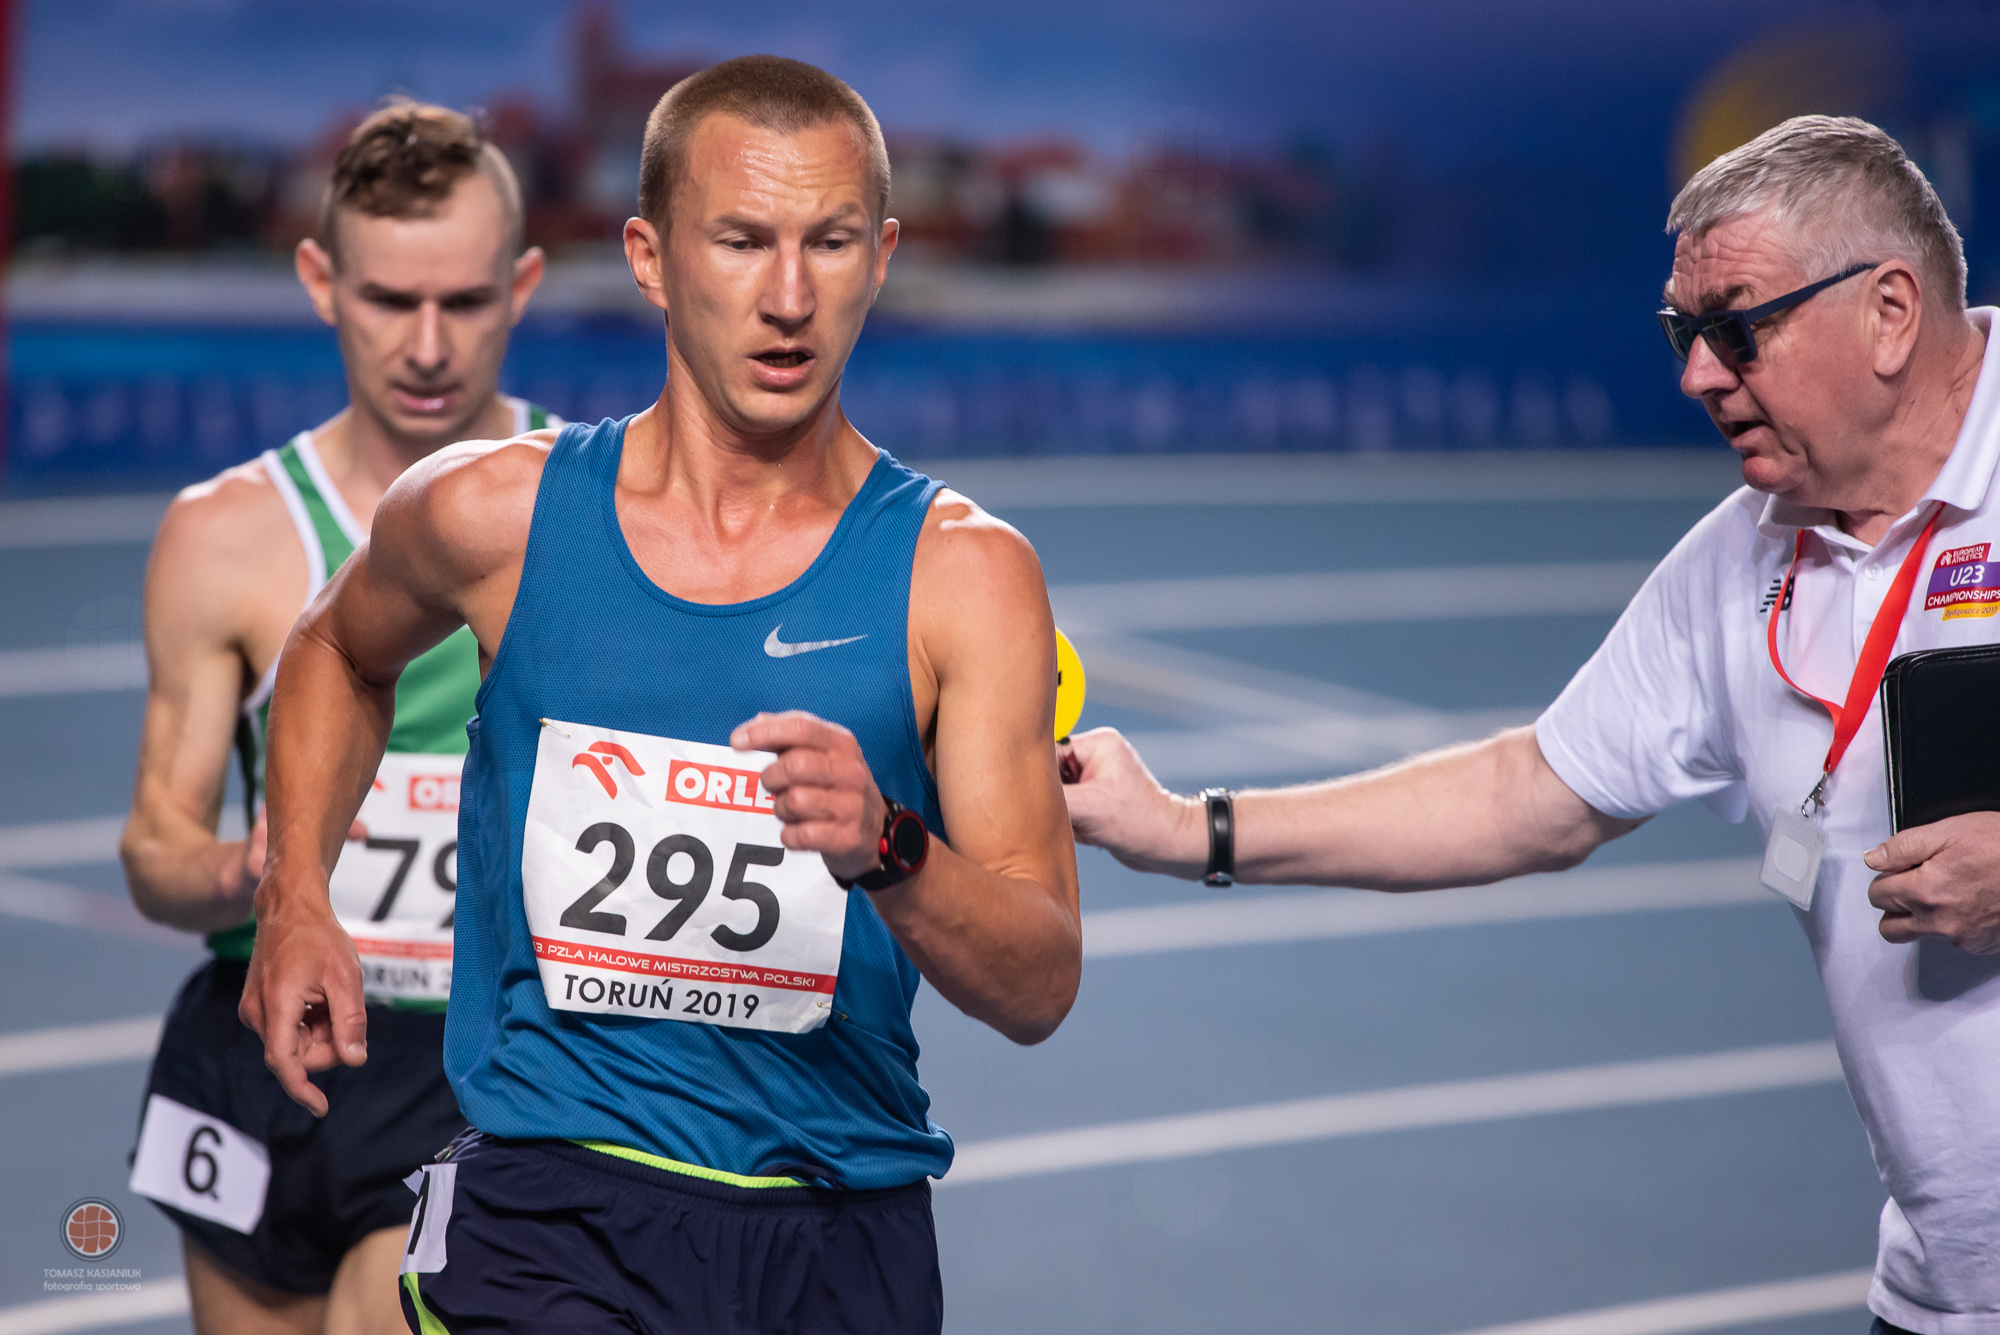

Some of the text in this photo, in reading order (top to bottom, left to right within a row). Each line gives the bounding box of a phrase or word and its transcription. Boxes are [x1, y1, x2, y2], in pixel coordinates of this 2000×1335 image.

[1951, 552, 1983, 564] ATHLETICS
[1953, 545, 1985, 557] EUROPEAN
[1949, 564, 1985, 587] U23
[1927, 590, 2000, 606] CHAMPIONSHIPS
[1945, 606, 1998, 618] Bydgoszcz 2017
[674, 767, 775, 810] ORLE
[559, 822, 786, 952] 295
[547, 944, 585, 960] PZLA
[588, 951, 650, 970] HALOWE
[653, 960, 760, 981] MISTRZOSTWA
[763, 973, 816, 987] POLSKI
[564, 974, 760, 1020] TORUŃ 2019
